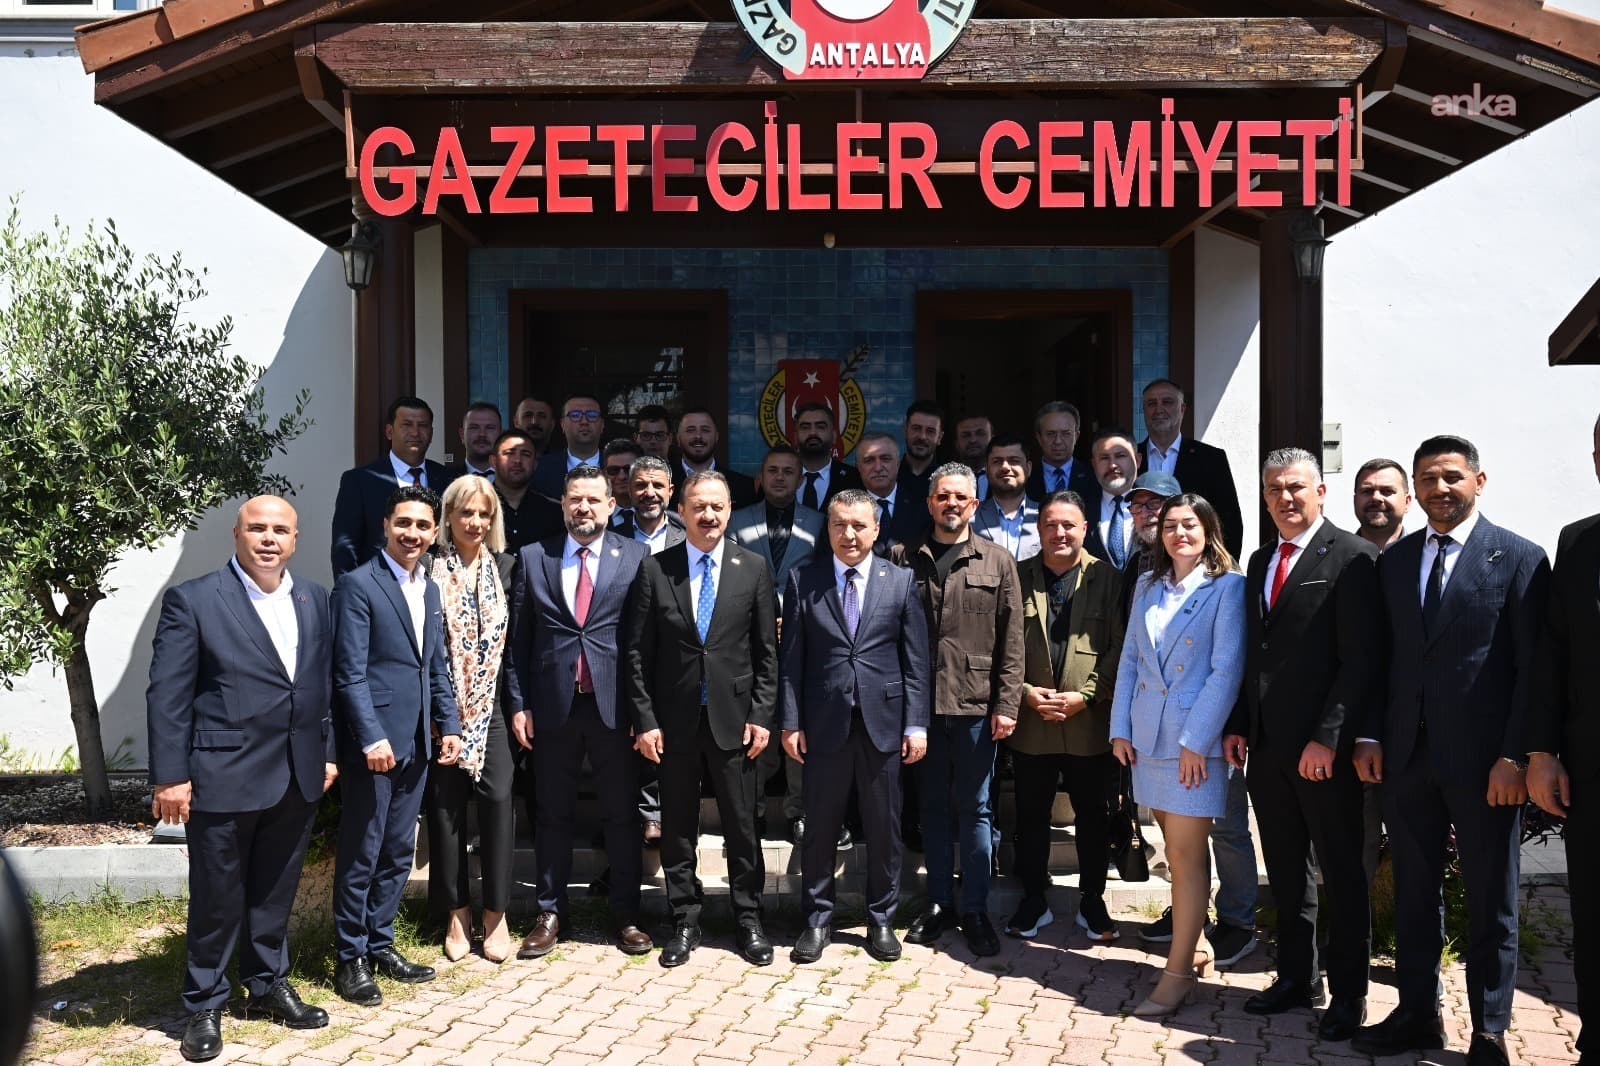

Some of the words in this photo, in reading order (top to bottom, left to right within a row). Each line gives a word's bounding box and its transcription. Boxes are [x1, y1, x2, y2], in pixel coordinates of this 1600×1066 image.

[744, 0, 797, 56] GAZ
[809, 43, 925, 65] ANTALYA
[360, 101, 942, 216] GAZETECİLER
[979, 98, 1351, 209] CEMİYETİ
